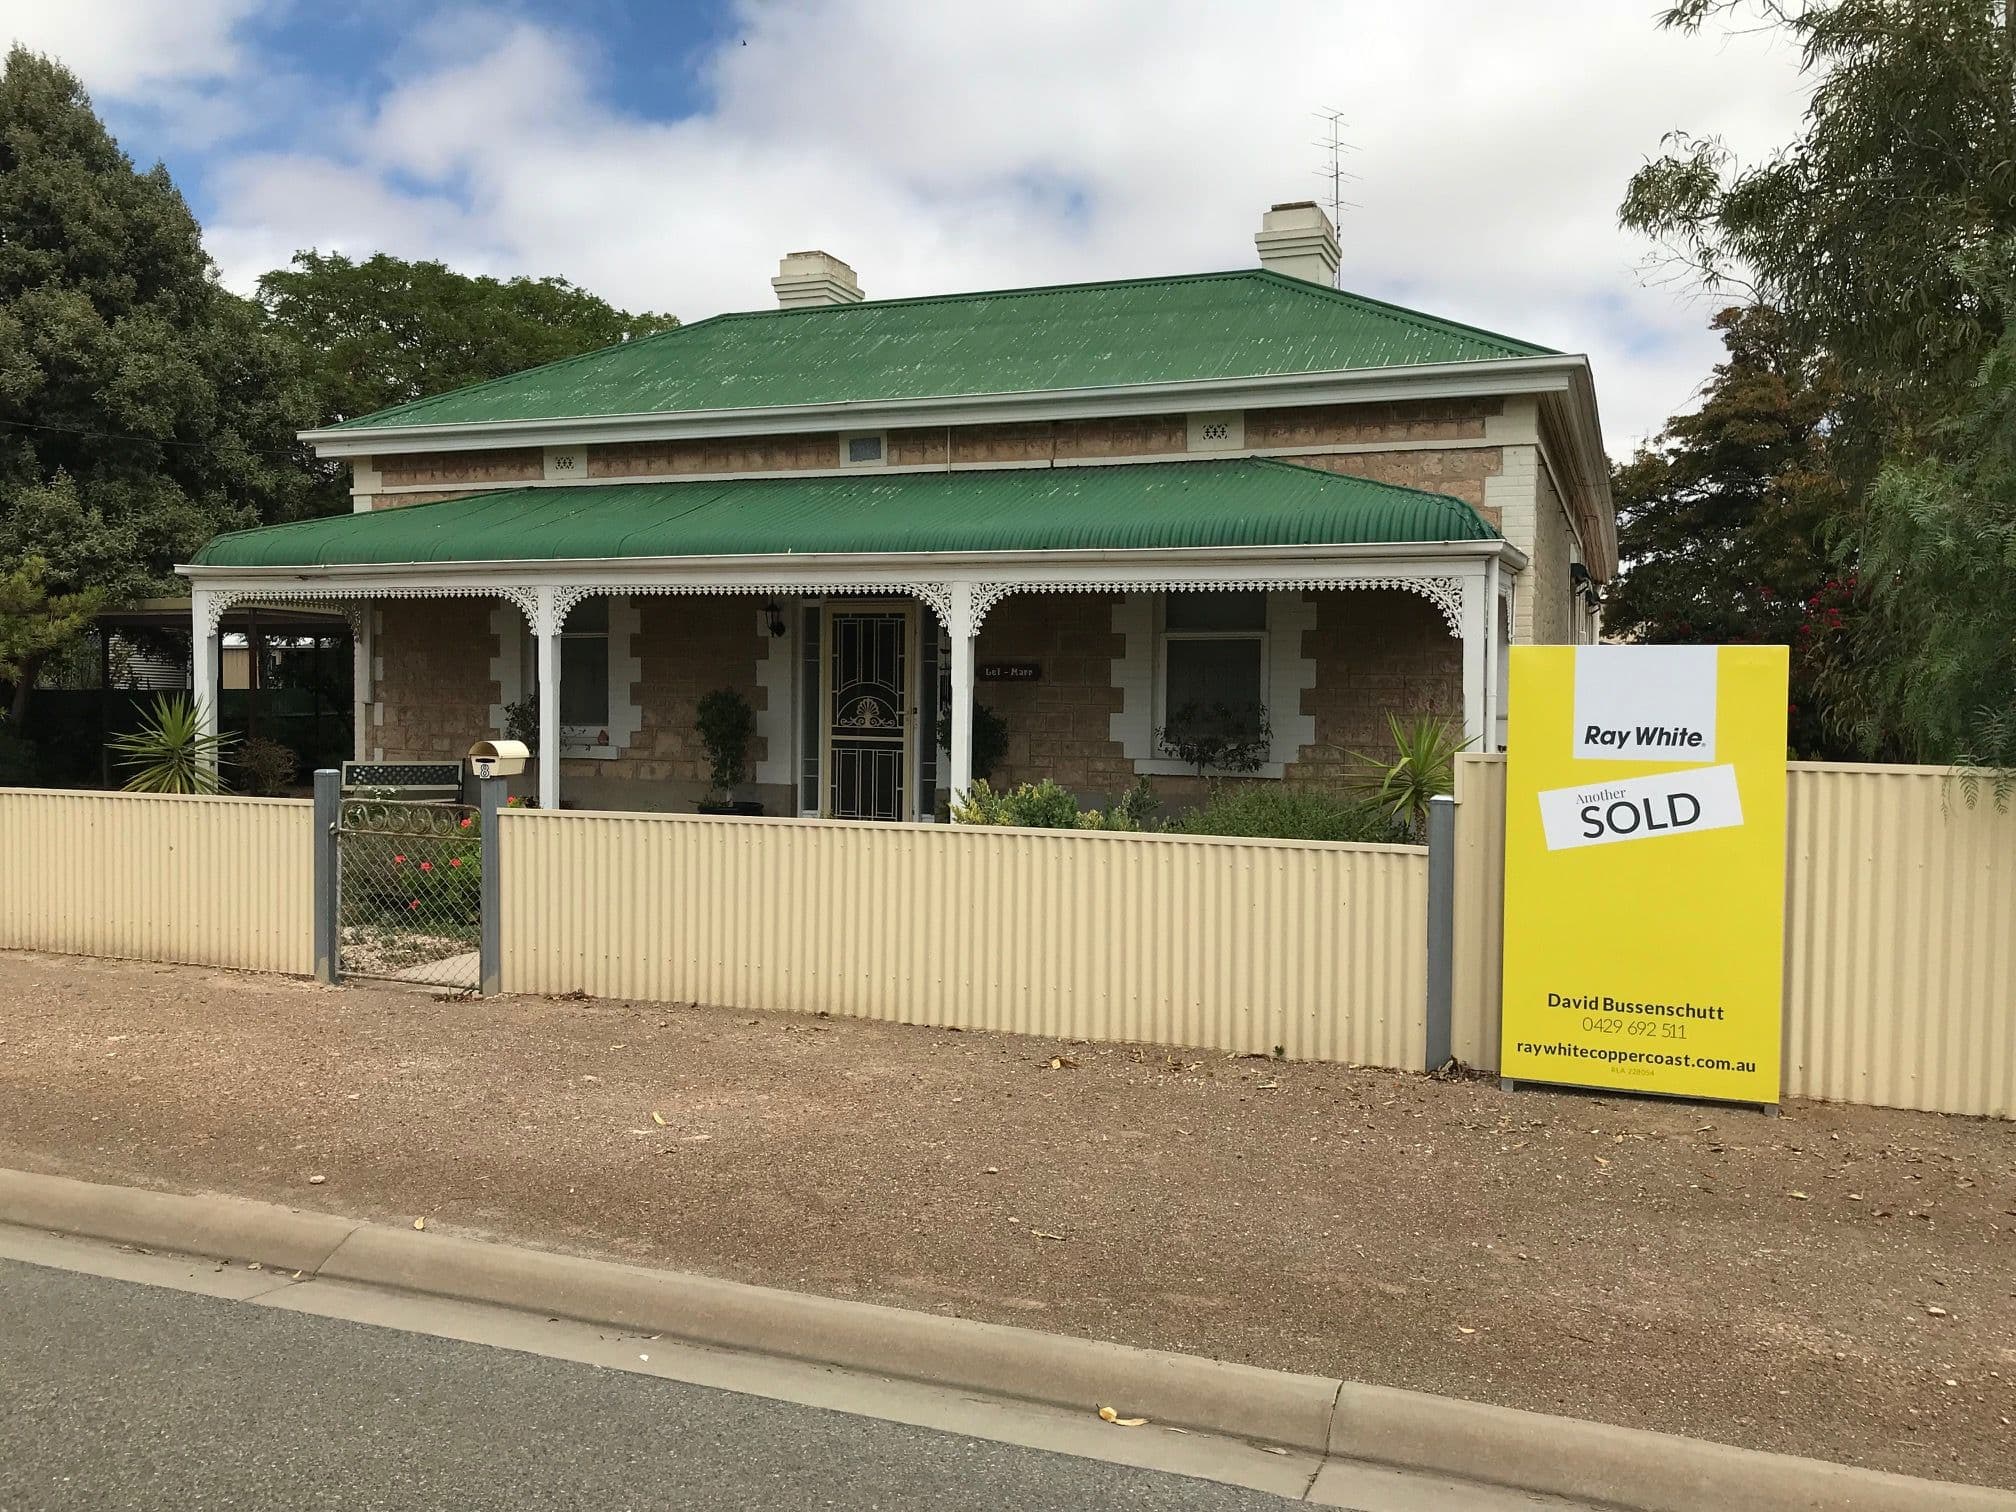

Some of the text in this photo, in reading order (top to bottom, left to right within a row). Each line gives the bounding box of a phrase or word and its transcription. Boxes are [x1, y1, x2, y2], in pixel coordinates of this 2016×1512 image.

[1584, 725, 1703, 749] Ray White
[481, 763, 490, 778] 8
[1576, 788, 1626, 805] Another
[1580, 792, 1701, 839] SOLD
[1547, 992, 1725, 1020] David Bussenschutt
[1582, 1016, 1687, 1040] 0429 692 511
[1516, 1040, 1756, 1073] raywhitecoppercoast.com.au
